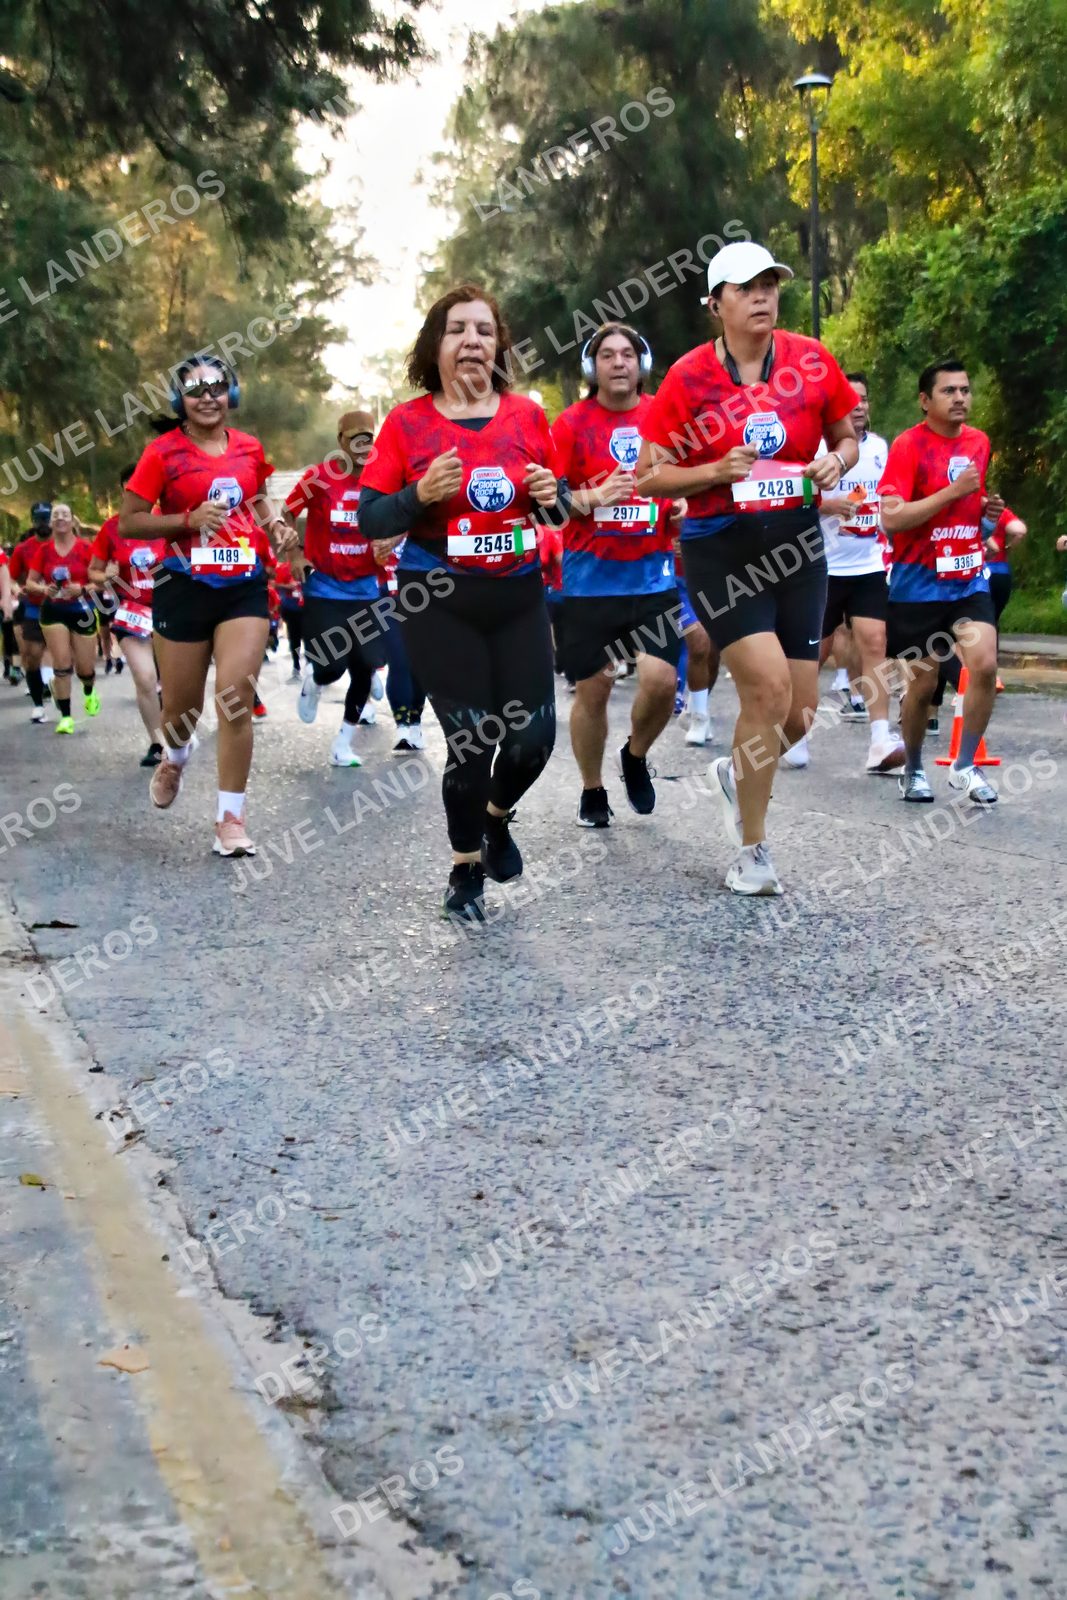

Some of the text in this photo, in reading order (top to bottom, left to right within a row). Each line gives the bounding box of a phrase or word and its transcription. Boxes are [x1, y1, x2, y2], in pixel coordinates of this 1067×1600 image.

[478, 480, 502, 489] Global
[758, 479, 794, 498] 2428
[840, 479, 879, 491] Emirat
[475, 488, 494, 497] Race
[344, 512, 358, 522] 238
[613, 507, 640, 520] 2977
[474, 534, 512, 554] 2545
[213, 549, 240, 563] 1489
